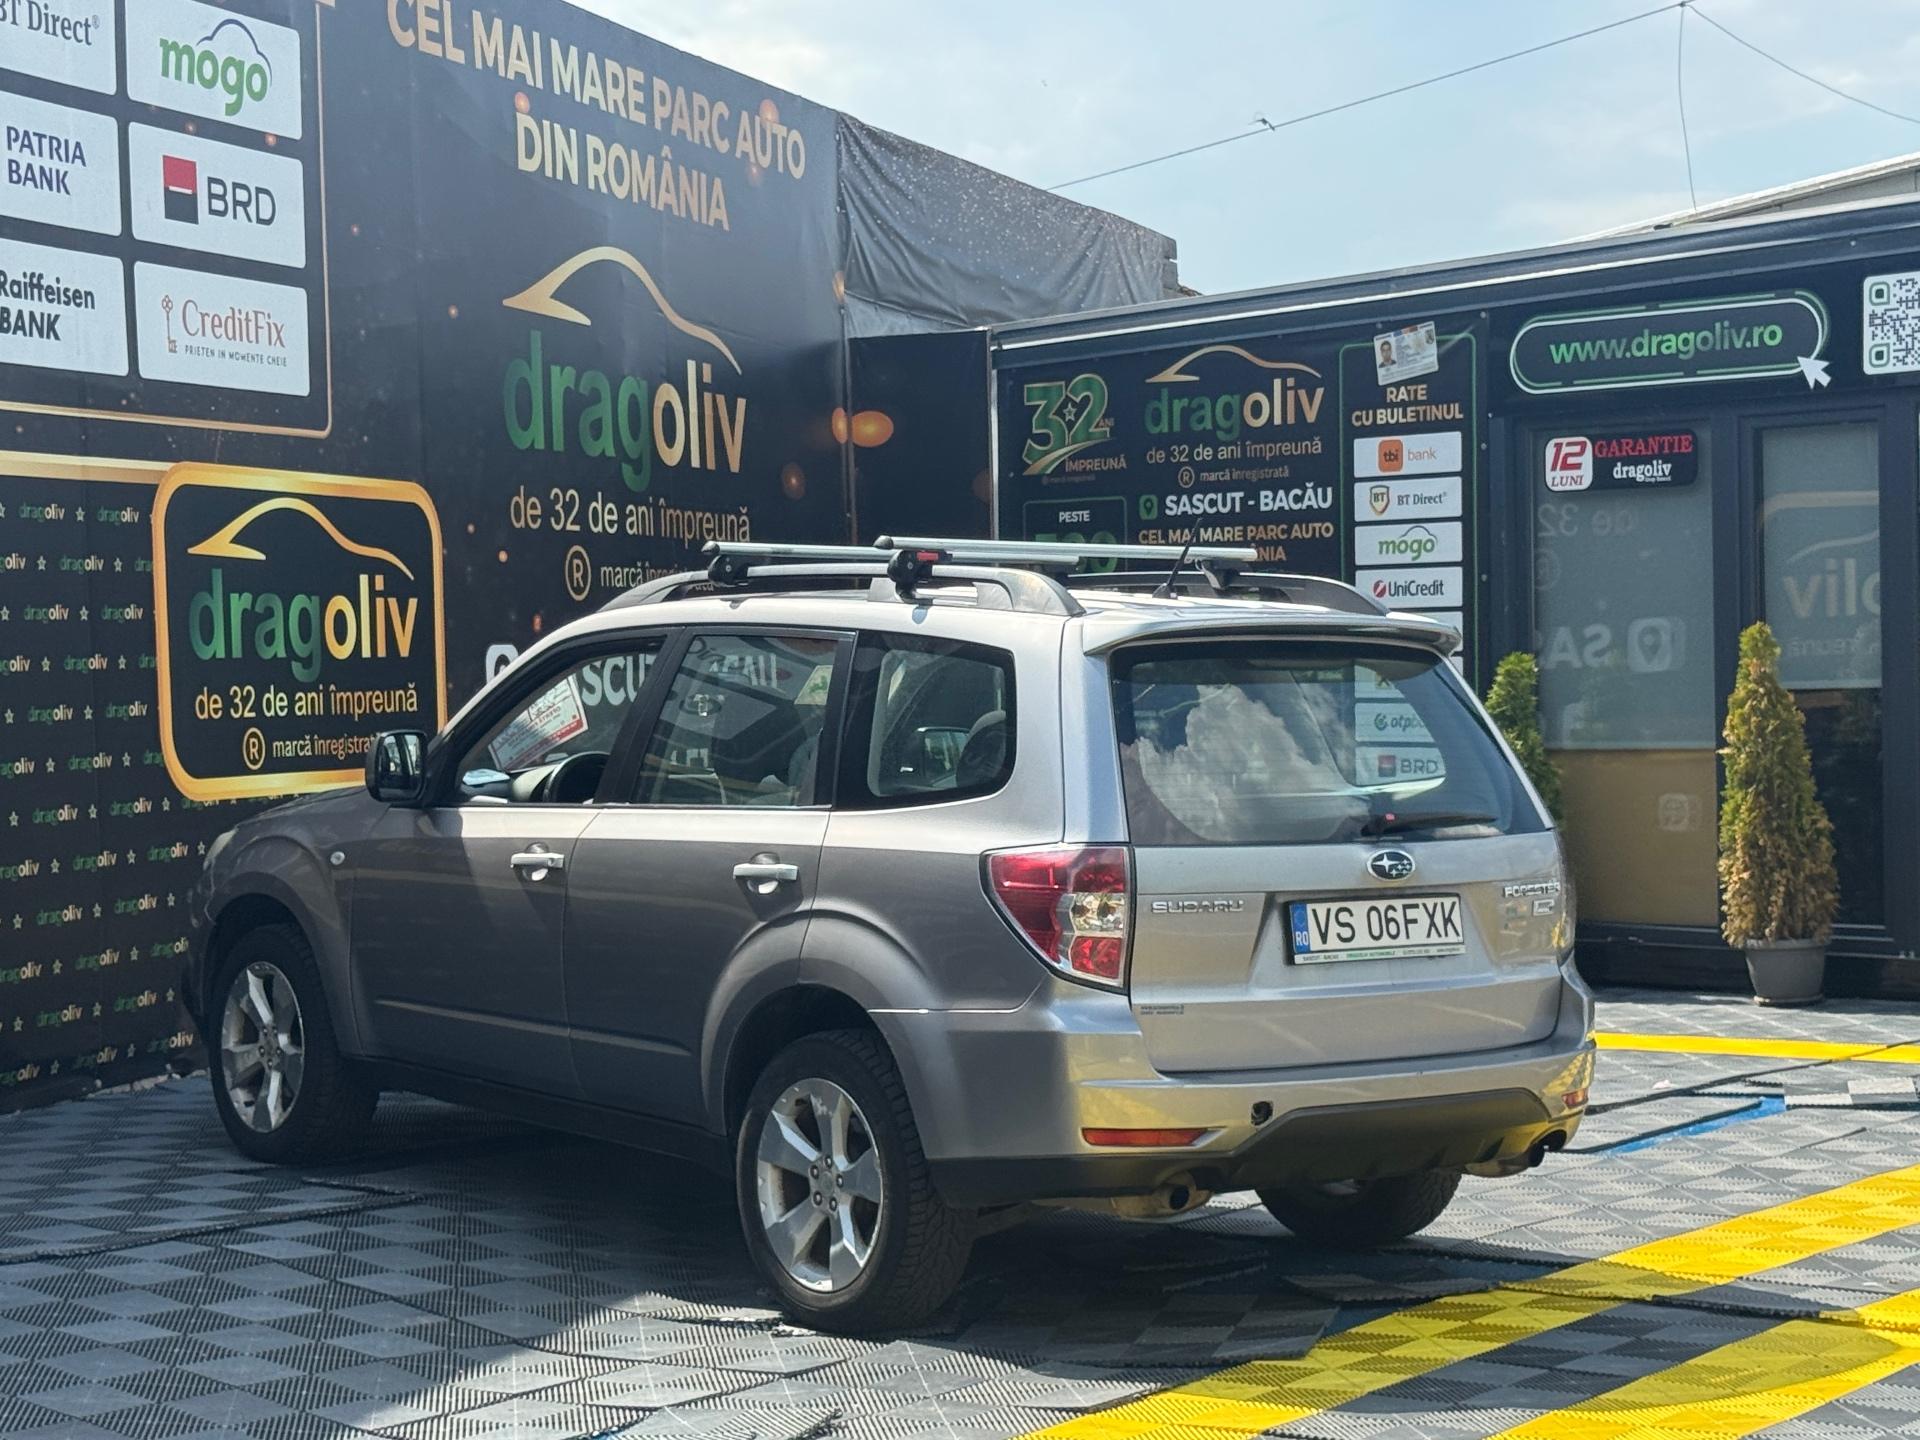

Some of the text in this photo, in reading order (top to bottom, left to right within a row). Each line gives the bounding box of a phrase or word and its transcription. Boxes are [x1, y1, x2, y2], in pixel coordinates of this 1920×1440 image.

[160, 37, 268, 117] mogo
[388, 0, 806, 180] CEL MAI MARE PARC AUTO
[6, 126, 87, 168] PATRIA
[7, 158, 71, 196] BANK
[516, 112, 730, 231] DIN ROMÂNIA
[207, 176, 276, 227] BRD
[0, 269, 96, 310] Raiffeisen
[0, 306, 61, 341] BANK
[182, 299, 286, 348] CreditFix
[1549, 321, 1783, 365] www.dragoliv.ro
[185, 344, 288, 368] PRIETEN IN MOMENTE CHEIE
[1386, 384, 1428, 403] RATE
[504, 330, 747, 493] dragoliv
[1023, 373, 1109, 467] 32
[1144, 377, 1325, 442] dragoliv
[1351, 403, 1464, 427] CU BULETINUL
[1146, 436, 1322, 464] de 32 de ani împreună
[1383, 447, 1438, 463] tbi bank
[1550, 440, 1587, 472] 12
[1594, 435, 1693, 458] GARANTIE
[1065, 453, 1128, 473] ÎMPREUNĂ
[1200, 469, 1231, 482] marcă
[1232, 466, 1289, 483] înregistrată
[1612, 459, 1672, 482] dragoliv
[1551, 474, 1584, 488] LUNI
[1165, 491, 1244, 516] SASCUT
[1259, 482, 1333, 512] BACĂU
[1396, 493, 1411, 506] BT
[19, 502, 65, 523] dragoliv
[97, 506, 140, 526] dragoliv
[510, 485, 750, 549] de 32 de ani împreună
[1058, 510, 1091, 523] PESTE
[1138, 529, 1166, 546] CEL
[1200, 526, 1243, 543] MARE
[1247, 524, 1288, 540] PARC
[1291, 521, 1334, 539] AUTO
[1378, 536, 1436, 561] mogo
[59, 554, 105, 575] dragoliv
[1388, 579, 1445, 597] UniCredit
[24, 603, 69, 624] dragoliv
[101, 603, 144, 624] dragoliv
[188, 567, 418, 683] dragoliv
[64, 653, 109, 674] dragoliv
[105, 701, 148, 721] dragoliv
[195, 682, 418, 721] de 32 de ani împreună
[28, 703, 74, 725] dragoliv
[272, 734, 313, 758] marcă
[313, 733, 376, 760] înregistra
[69, 751, 113, 774] dragoliv
[1401, 758, 1439, 774] BRD
[32, 804, 78, 827] dragoliv
[109, 796, 152, 818] dragoliv
[73, 850, 117, 873] dragoliv
[37, 904, 83, 927] dragoliv
[114, 894, 158, 916] dragoliv
[1151, 900, 1244, 913] SUBARU
[1311, 906, 1356, 945] VS
[1295, 931, 1308, 947] RO
